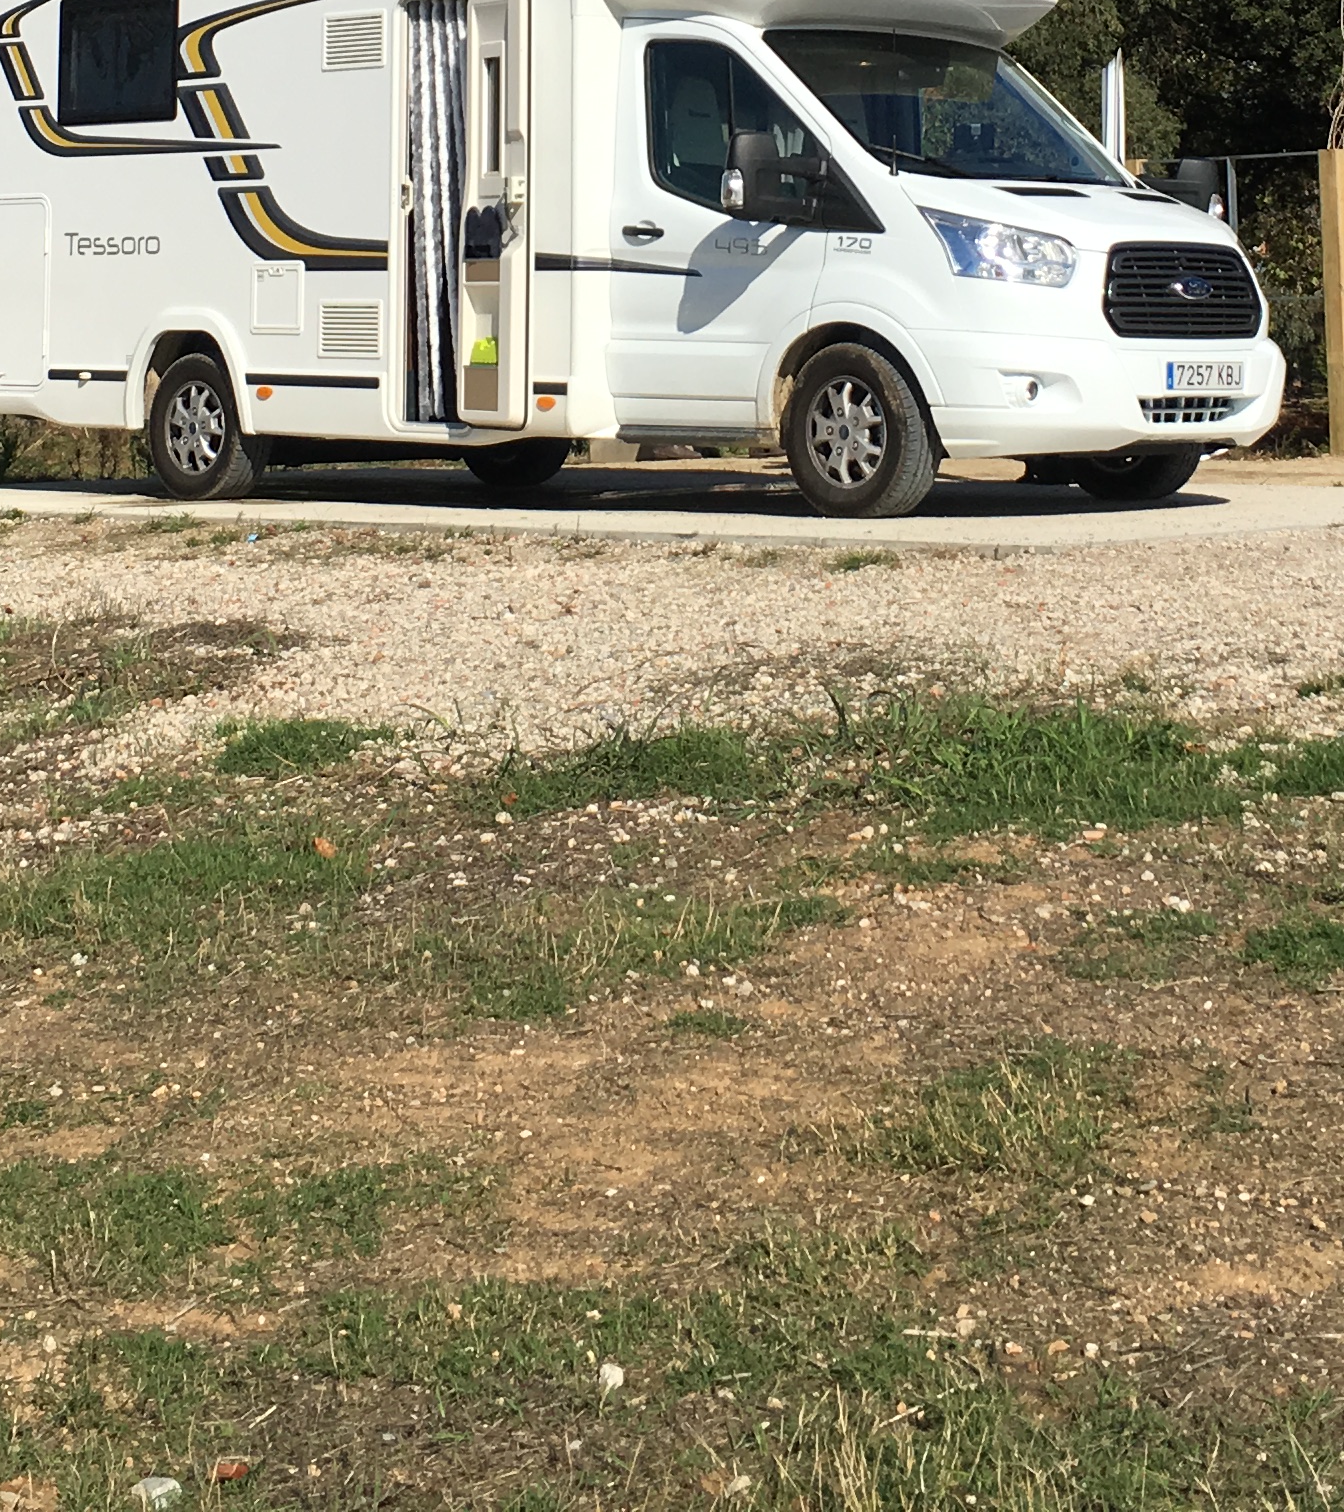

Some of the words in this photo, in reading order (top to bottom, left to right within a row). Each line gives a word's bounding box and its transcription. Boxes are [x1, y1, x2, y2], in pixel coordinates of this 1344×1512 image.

[63, 232, 161, 256] Tessoro
[837, 235, 873, 250] 170
[1176, 364, 1213, 386] 7257
[1217, 364, 1242, 386] KBJ
